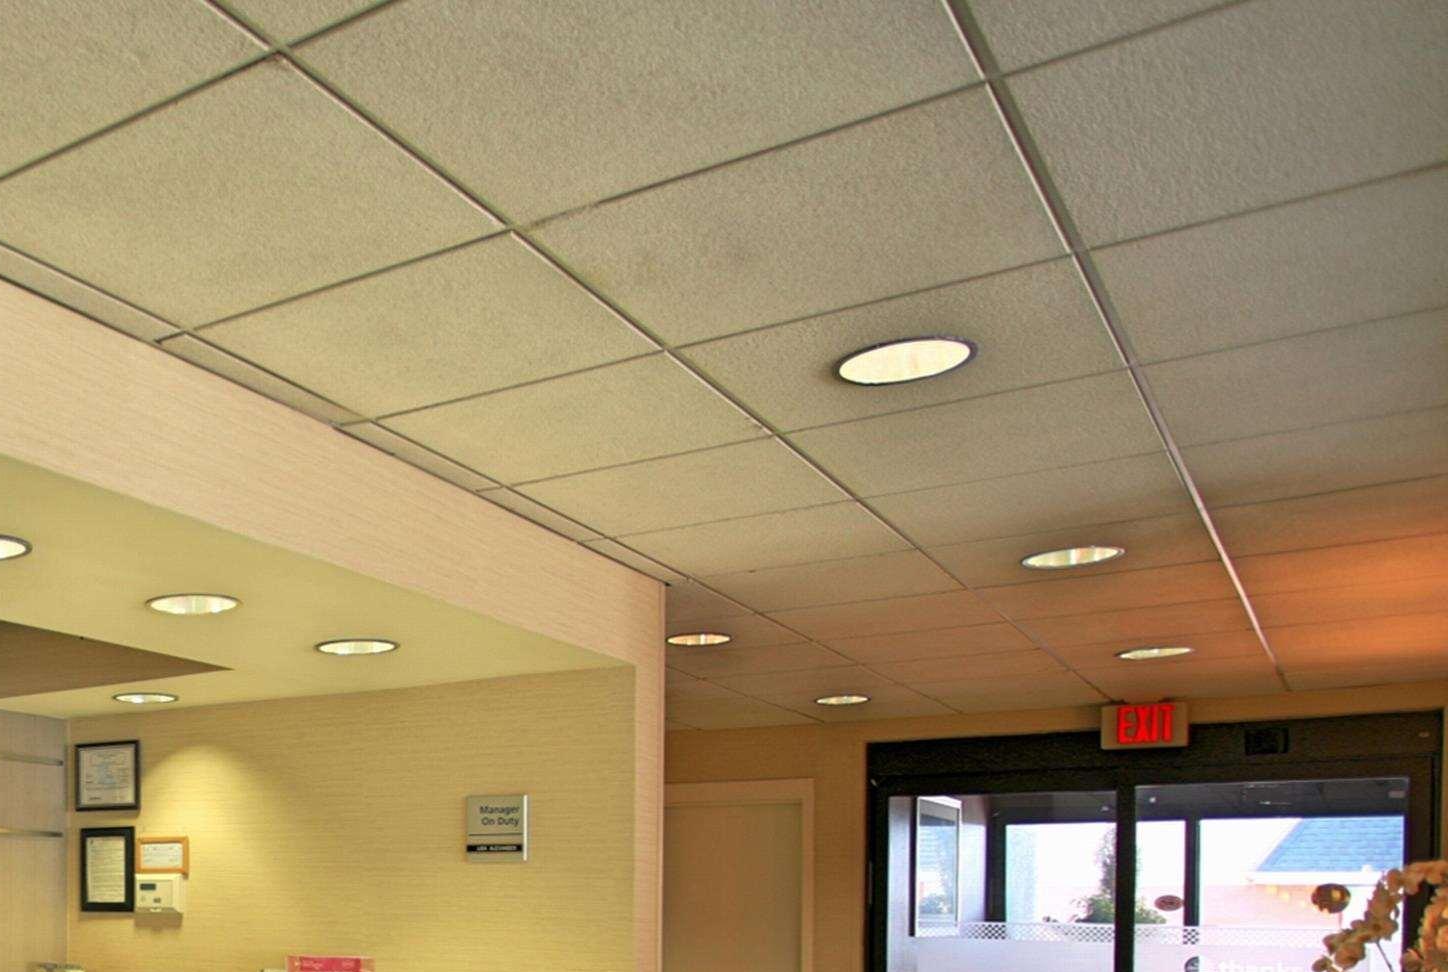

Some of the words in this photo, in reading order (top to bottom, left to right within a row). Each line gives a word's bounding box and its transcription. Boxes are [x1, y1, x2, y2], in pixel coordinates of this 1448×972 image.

[1118, 705, 1176, 743] EXIT
[480, 805, 520, 815] Manager
[481, 816, 496, 826] On
[497, 816, 520, 828] Duty
